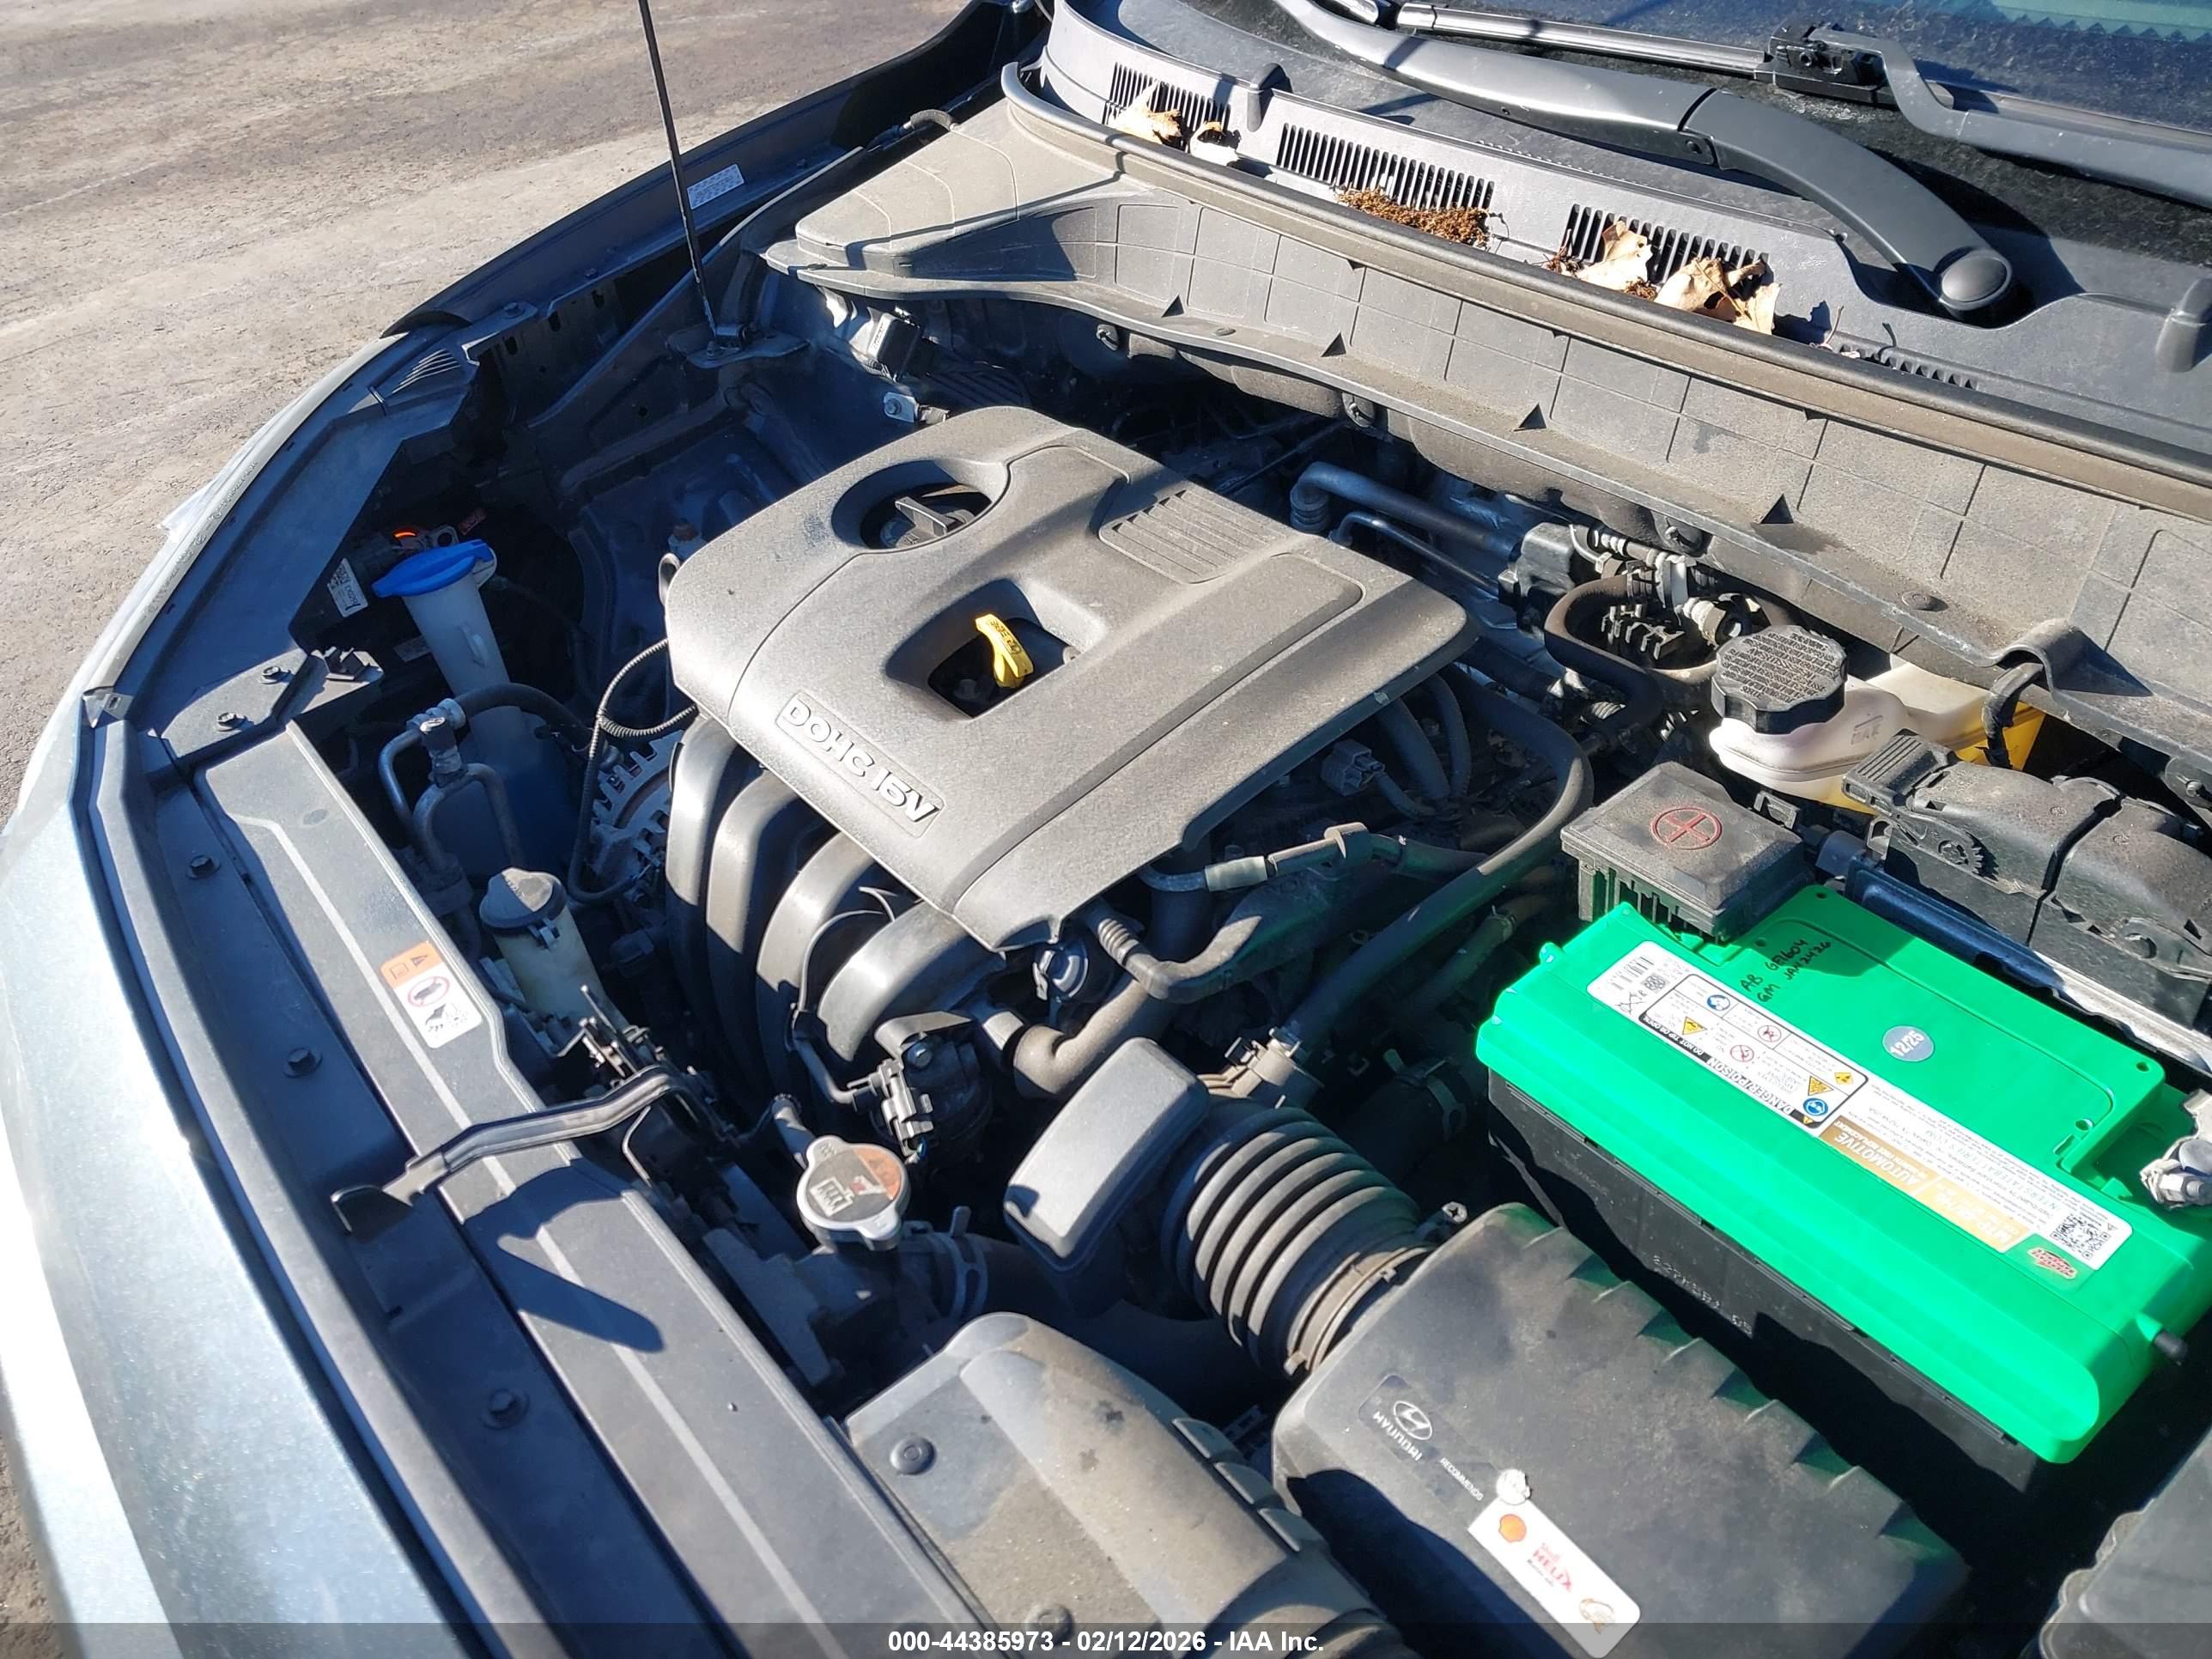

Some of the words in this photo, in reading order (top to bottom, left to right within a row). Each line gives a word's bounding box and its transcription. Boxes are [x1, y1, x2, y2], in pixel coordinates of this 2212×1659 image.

[782, 696, 876, 777] DOHC
[872, 767, 939, 823] 16V
[1740, 974, 1765, 993] AB
[1756, 982, 1781, 1003] GM
[1677, 1037, 1694, 1050] NOT
[1890, 1030, 1924, 1056] 12/25
[1705, 1056, 1794, 1115] DANGER/POISON
[1833, 1131, 1922, 1186] AUTOMOTIVE
[1372, 1411, 1422, 1461] HYUNDAI
[1440, 1457, 1484, 1501] RECOMMENDS
